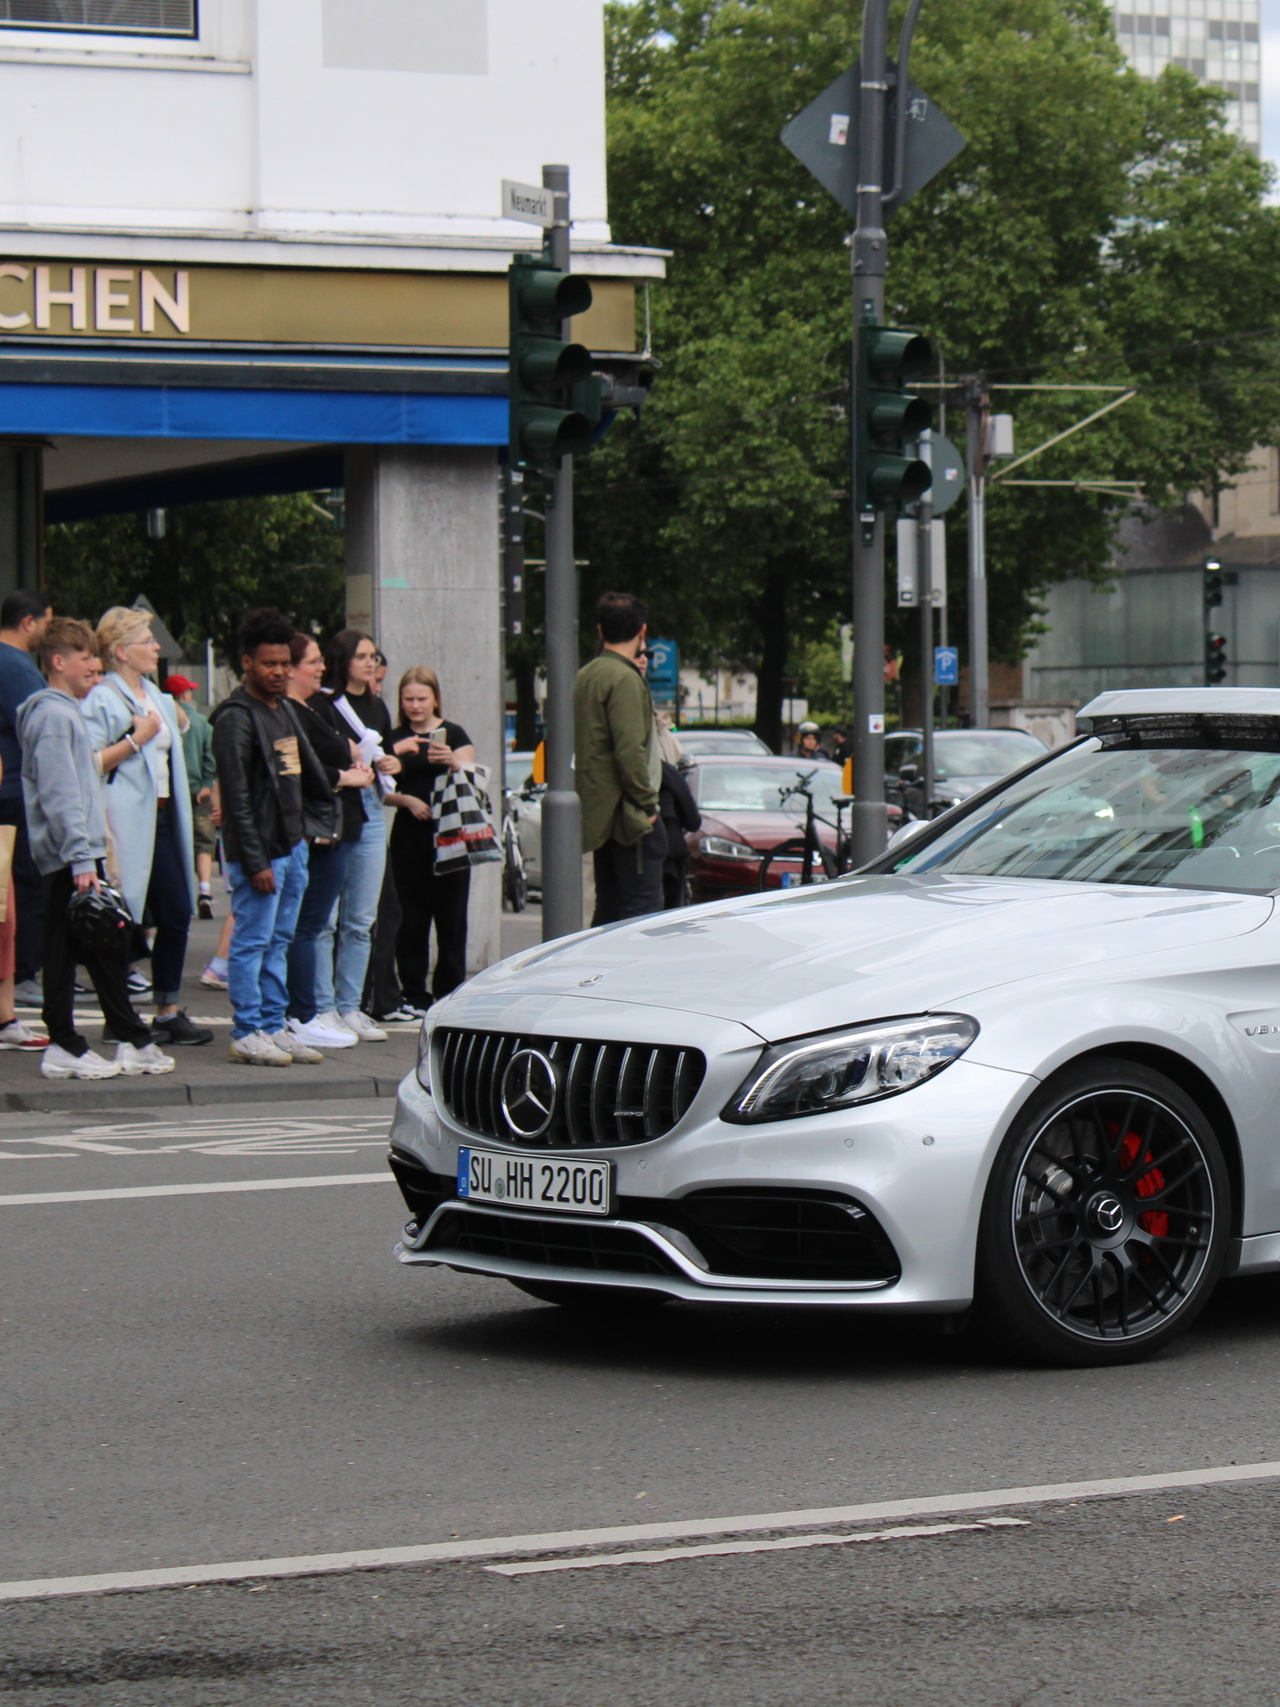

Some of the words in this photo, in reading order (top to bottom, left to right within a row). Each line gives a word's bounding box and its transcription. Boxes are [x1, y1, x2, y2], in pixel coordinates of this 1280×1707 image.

[510, 187, 547, 217] Neumarkt
[0, 263, 190, 334] CHEN
[1244, 1024, 1269, 1037] V8
[470, 1155, 492, 1194] SU
[506, 1160, 533, 1200] HH
[541, 1165, 604, 1206] 2200
